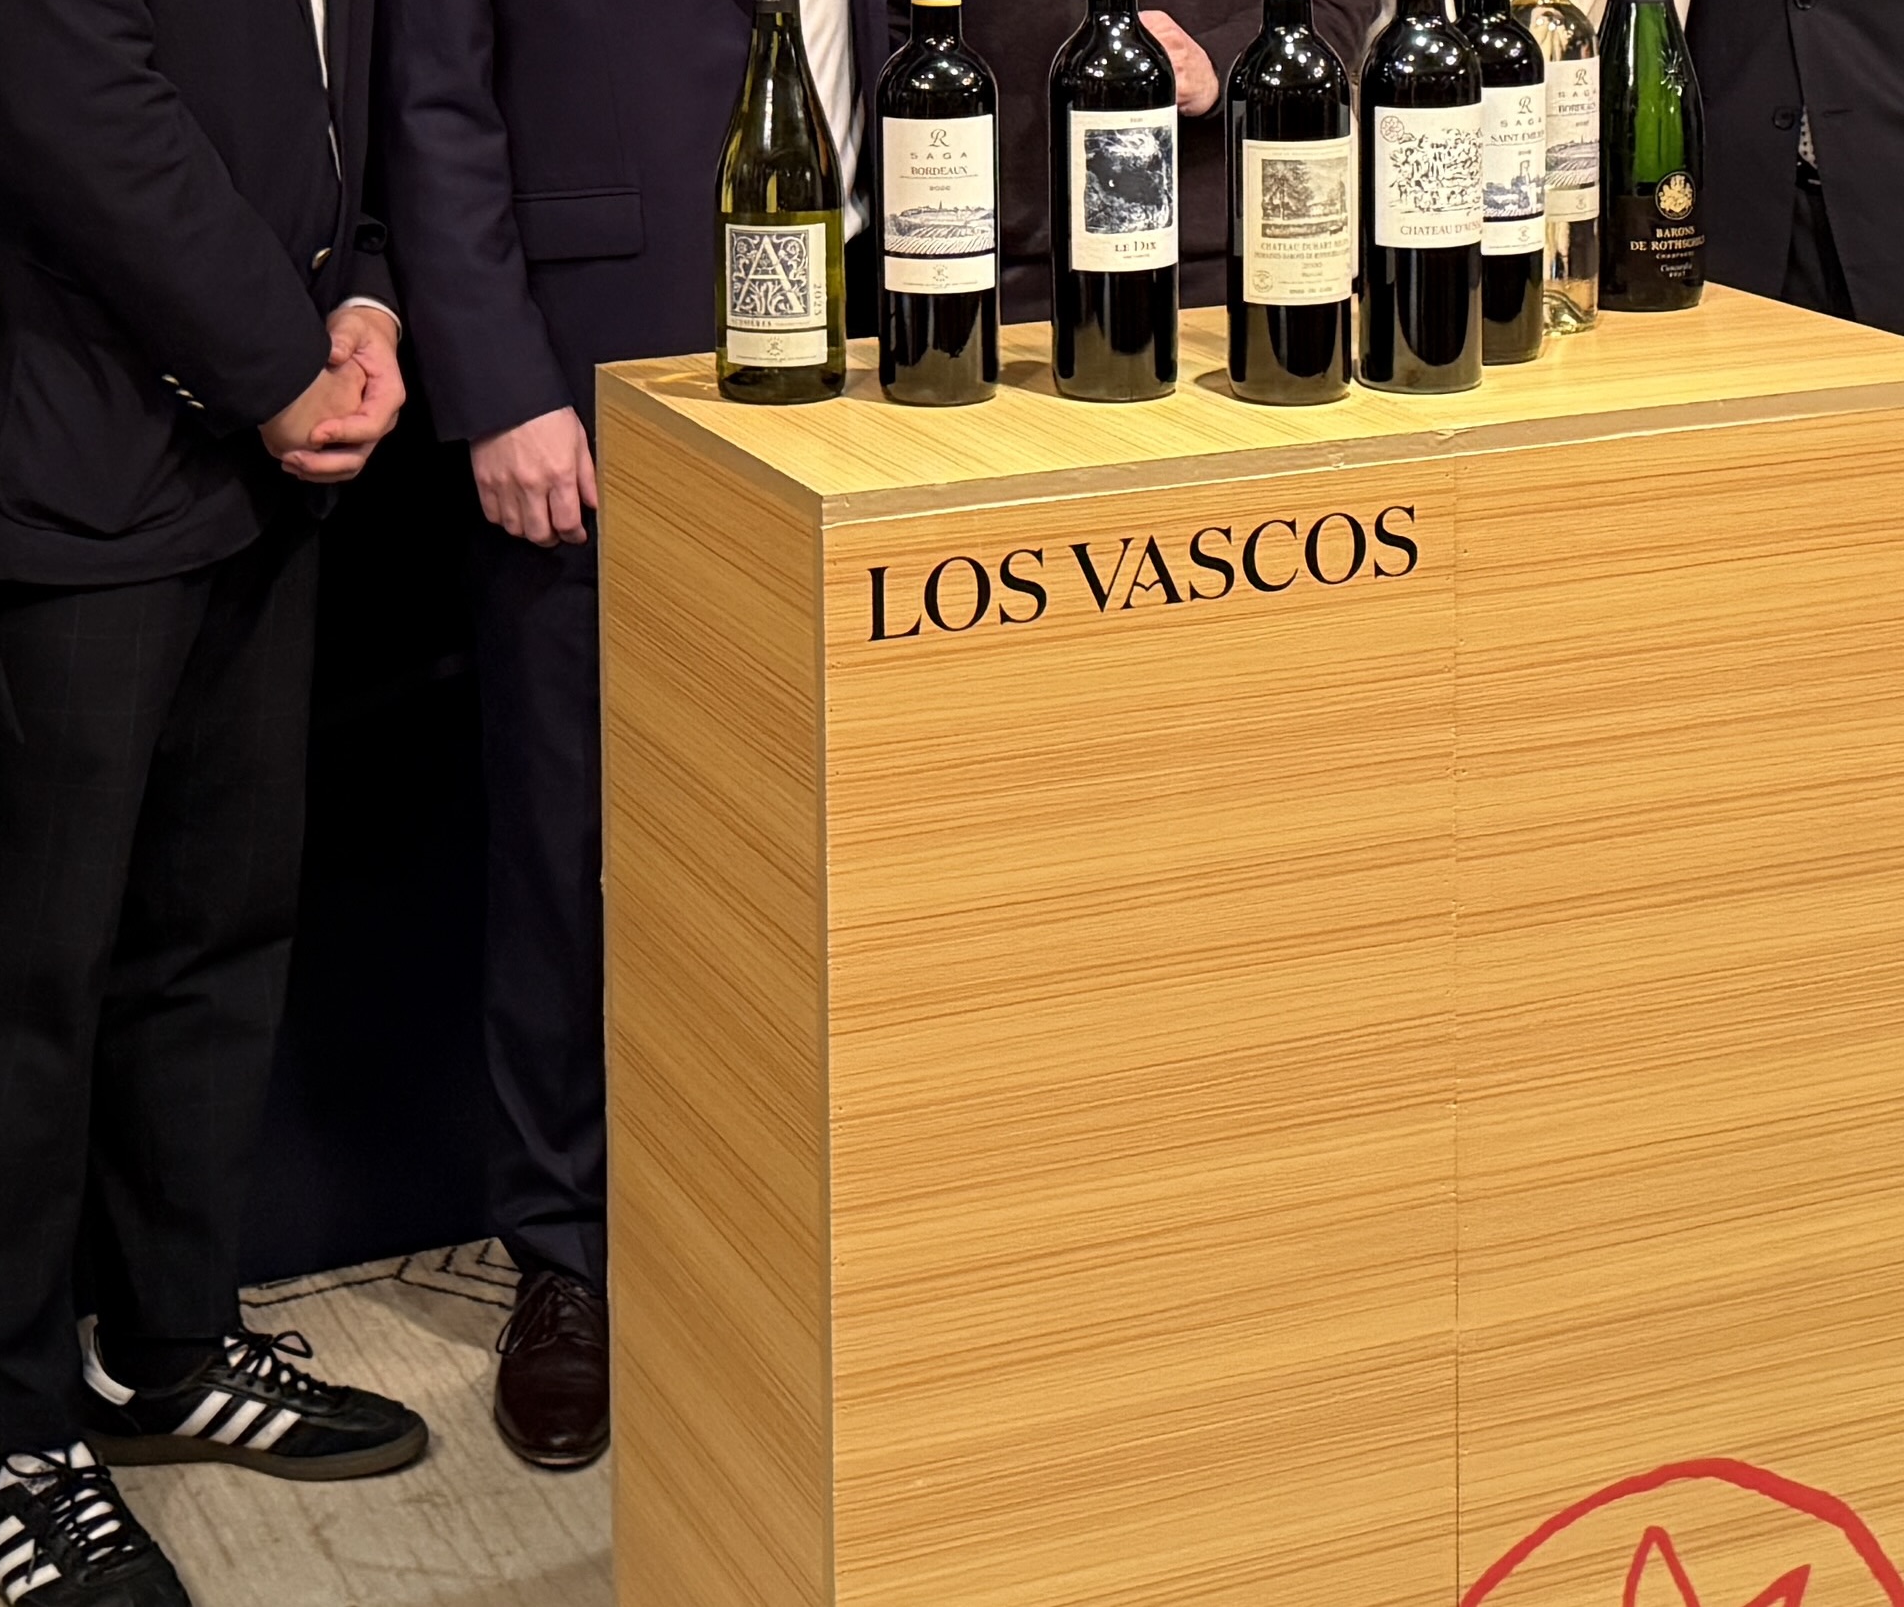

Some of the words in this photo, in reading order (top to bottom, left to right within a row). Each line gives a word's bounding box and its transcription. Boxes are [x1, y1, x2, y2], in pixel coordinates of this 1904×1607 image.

[910, 152, 968, 160] SAGA
[910, 165, 970, 176] BORDEAUX
[1656, 226, 1695, 238] BARONS
[1630, 240, 1648, 251] DE
[867, 548, 1047, 642] LOS
[1069, 505, 1419, 613] VASCOS
